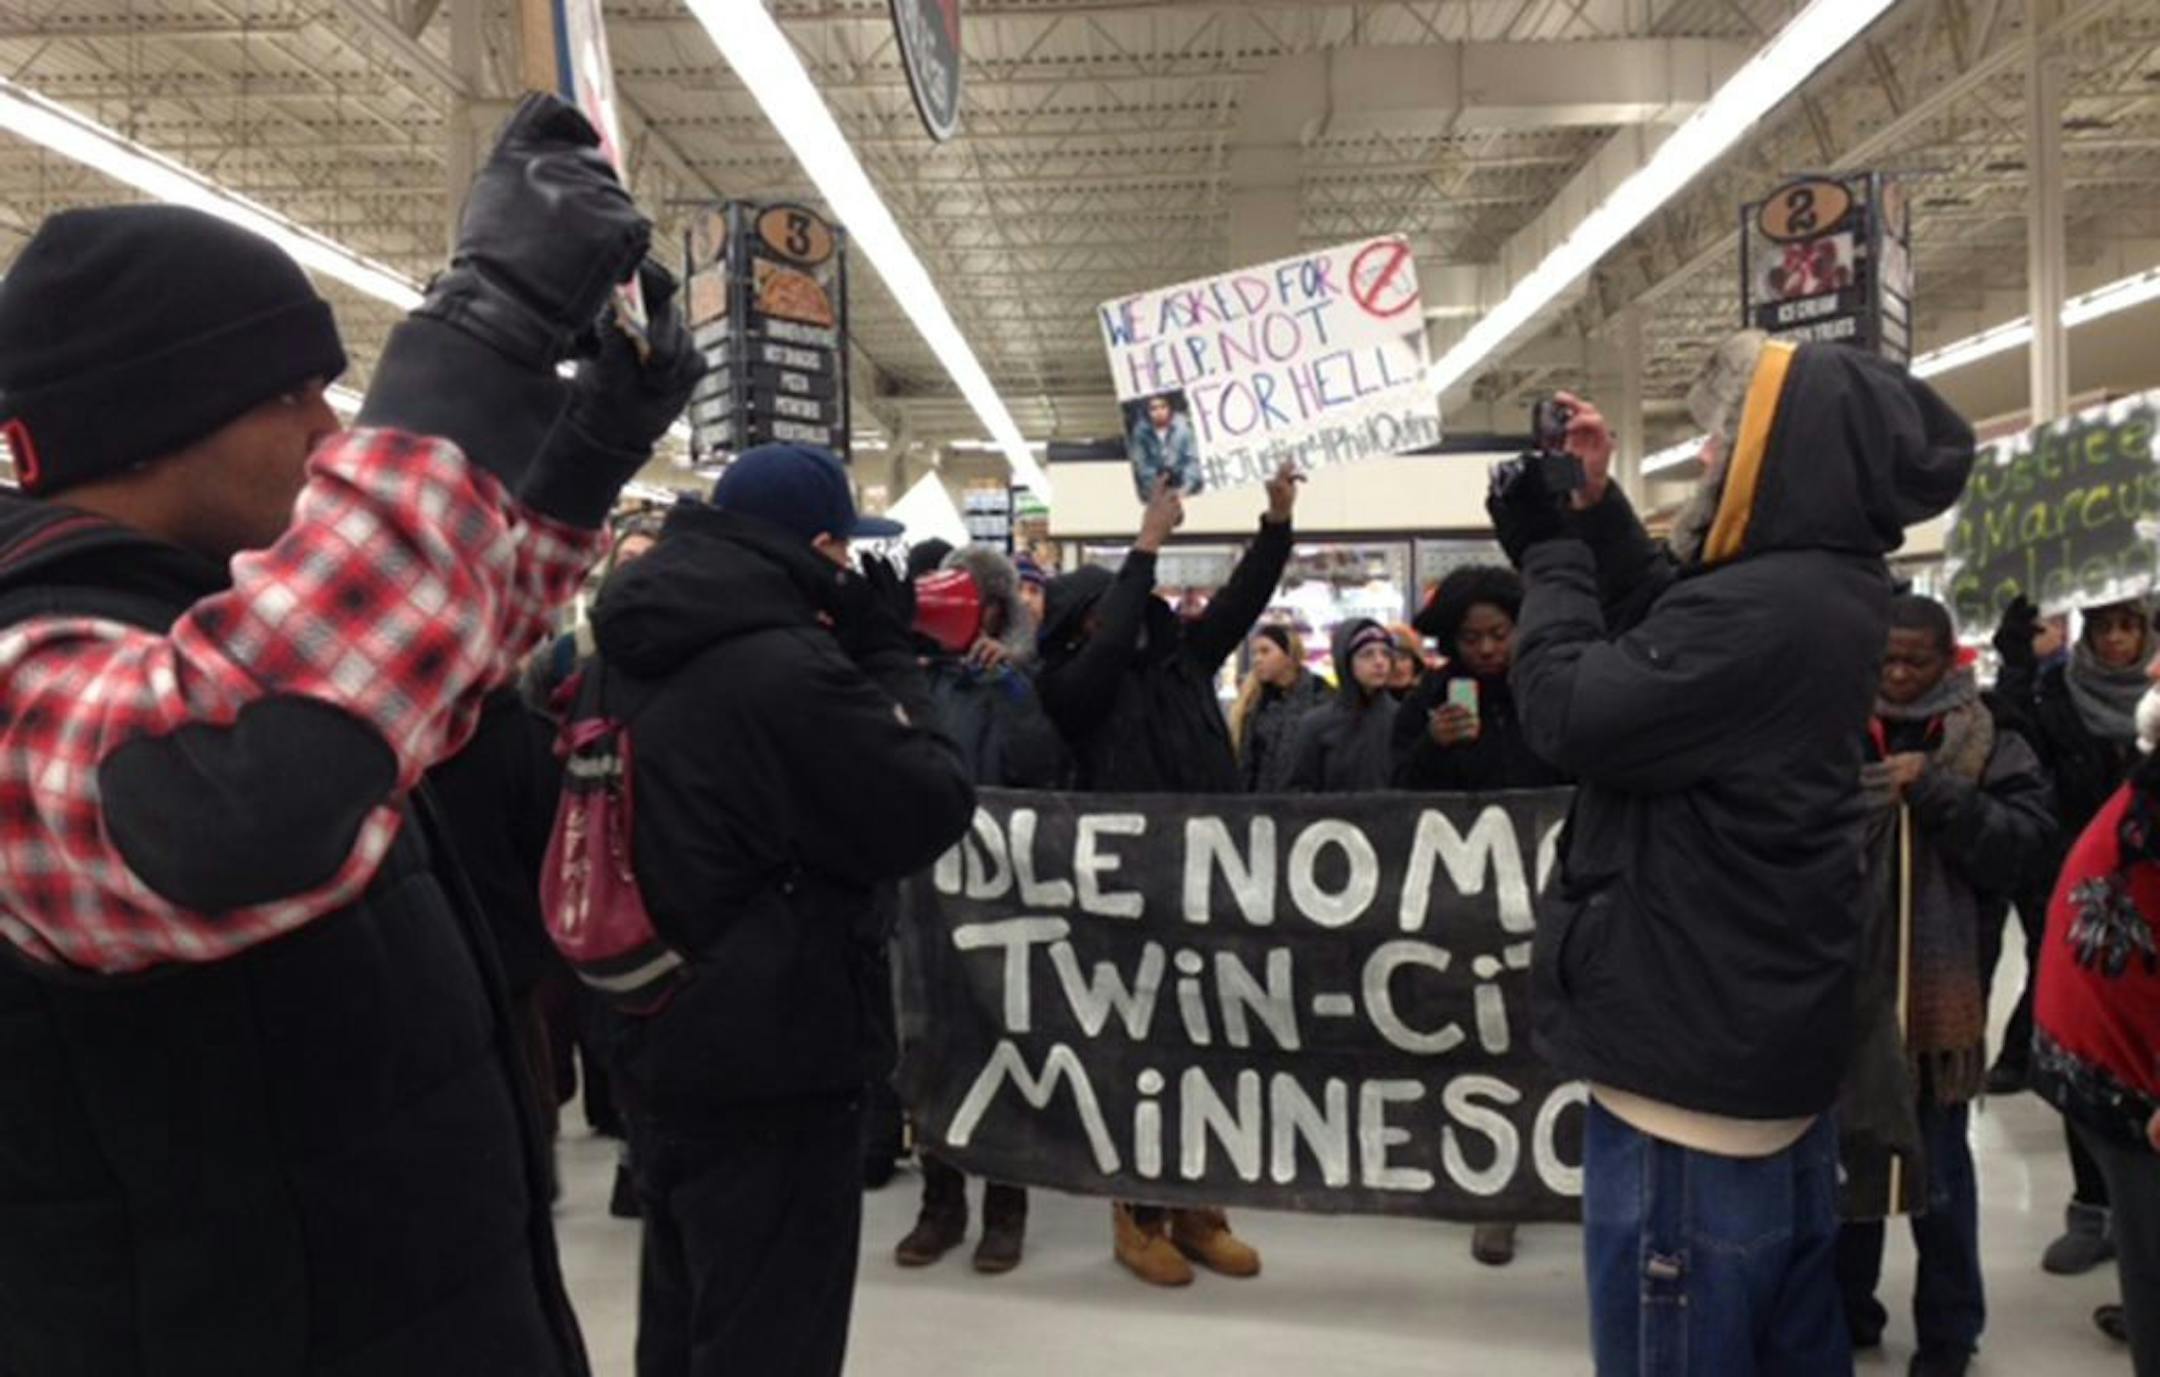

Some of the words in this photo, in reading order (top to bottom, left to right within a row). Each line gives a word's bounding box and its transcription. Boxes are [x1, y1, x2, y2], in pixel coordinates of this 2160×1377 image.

[786, 212, 811, 256] 3
[1786, 188, 1817, 233] 2
[1102, 297, 1150, 347] WE
[1158, 275, 1271, 335] ASKED
[1275, 256, 1343, 305] FOR
[1217, 300, 1335, 372] NOT
[1193, 372, 1292, 443] FOR
[1182, 814, 1380, 927] NO
